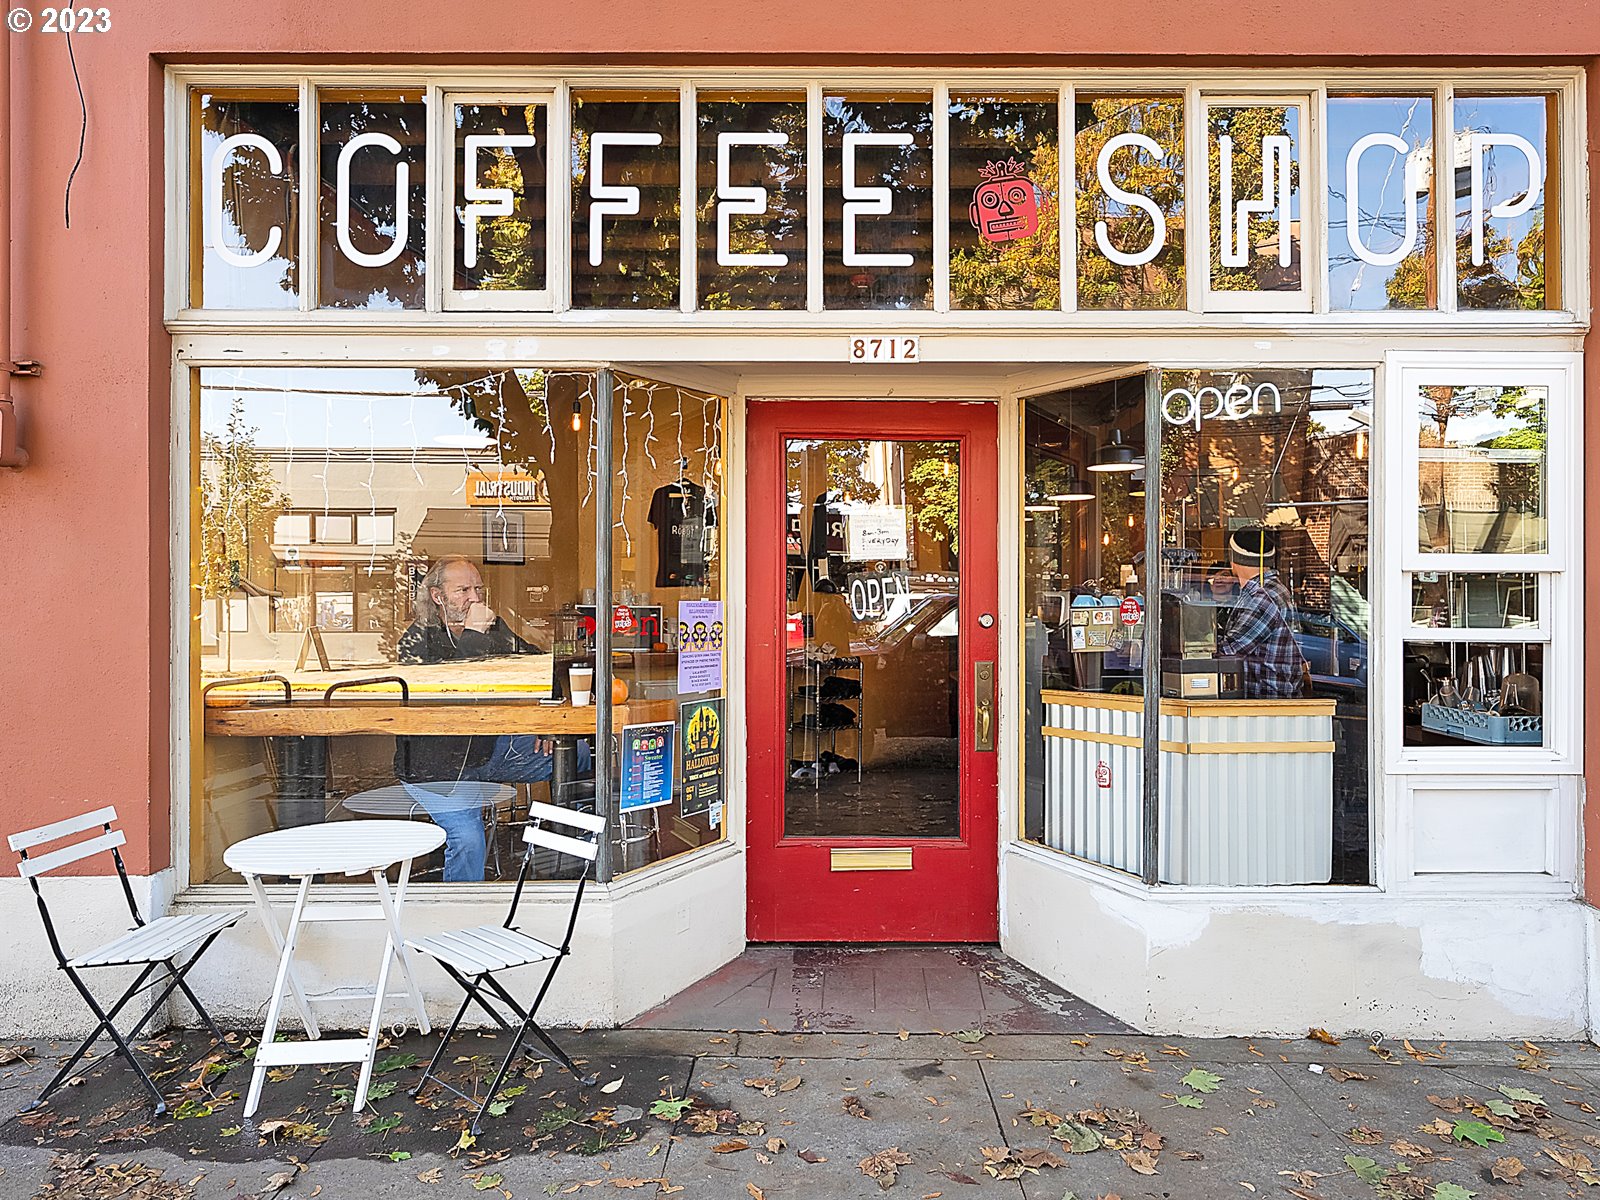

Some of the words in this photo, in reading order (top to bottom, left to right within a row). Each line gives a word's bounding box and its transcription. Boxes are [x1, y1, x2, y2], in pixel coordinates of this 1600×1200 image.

[210, 132, 915, 268] COFFEE
[1094, 132, 1542, 268] SHOP
[853, 339, 916, 358] 8712
[1162, 382, 1281, 432] open
[851, 575, 912, 620] OPEN
[686, 754, 719, 771] HALLOWEEN
